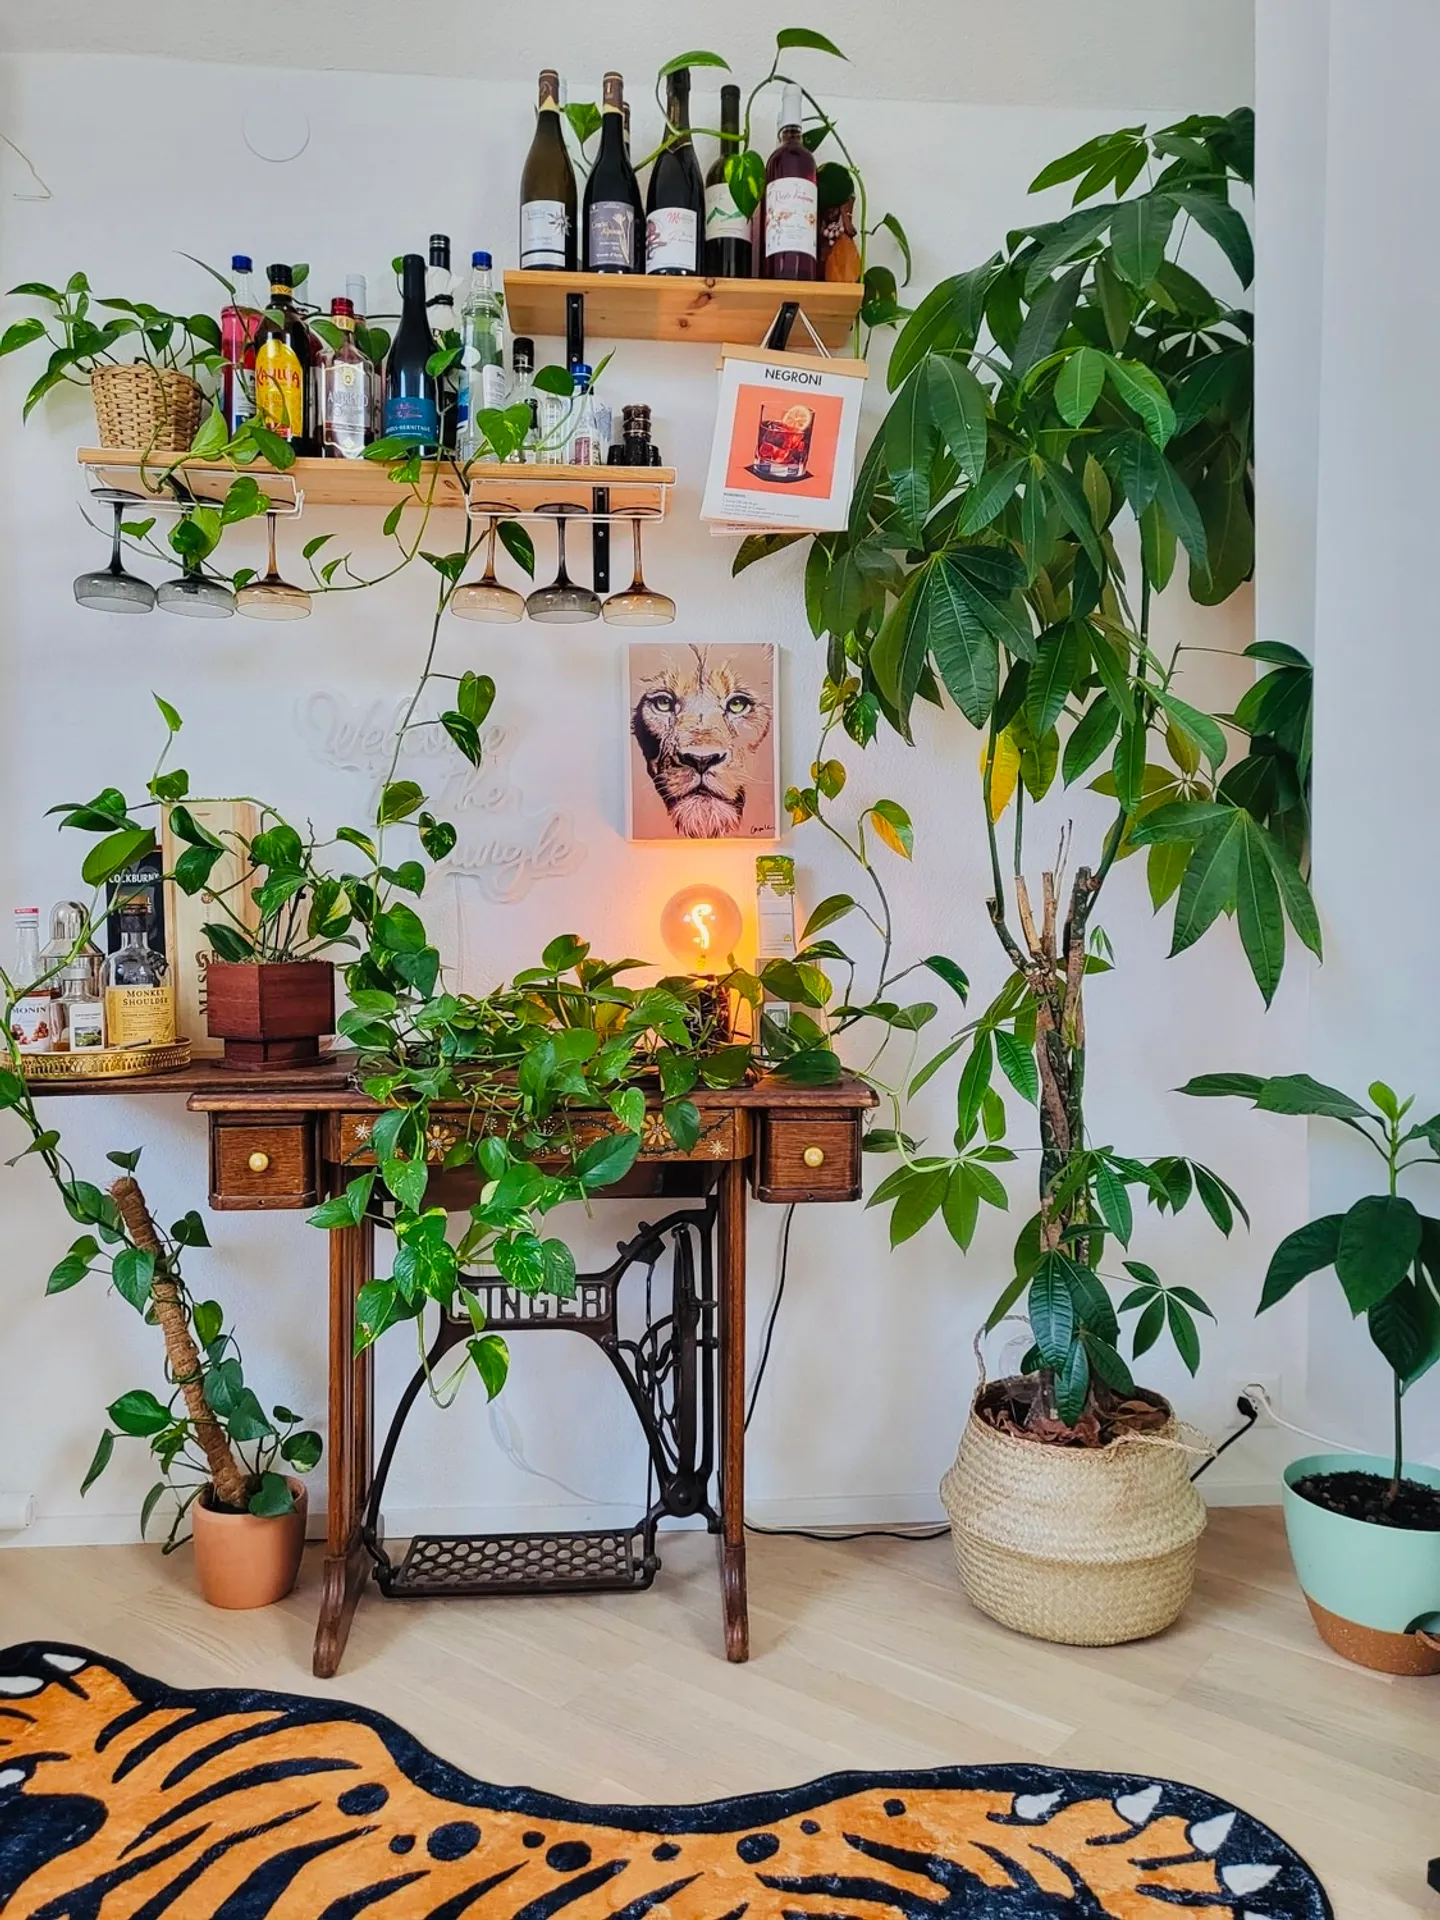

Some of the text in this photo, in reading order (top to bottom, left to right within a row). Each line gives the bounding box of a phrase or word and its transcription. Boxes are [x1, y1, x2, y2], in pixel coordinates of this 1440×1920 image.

[765, 368, 822, 386] NEGRONI
[307, 690, 509, 757] Welcoe
[126, 989, 165, 998] MONKEY
[12, 1006, 47, 1014] MONIN
